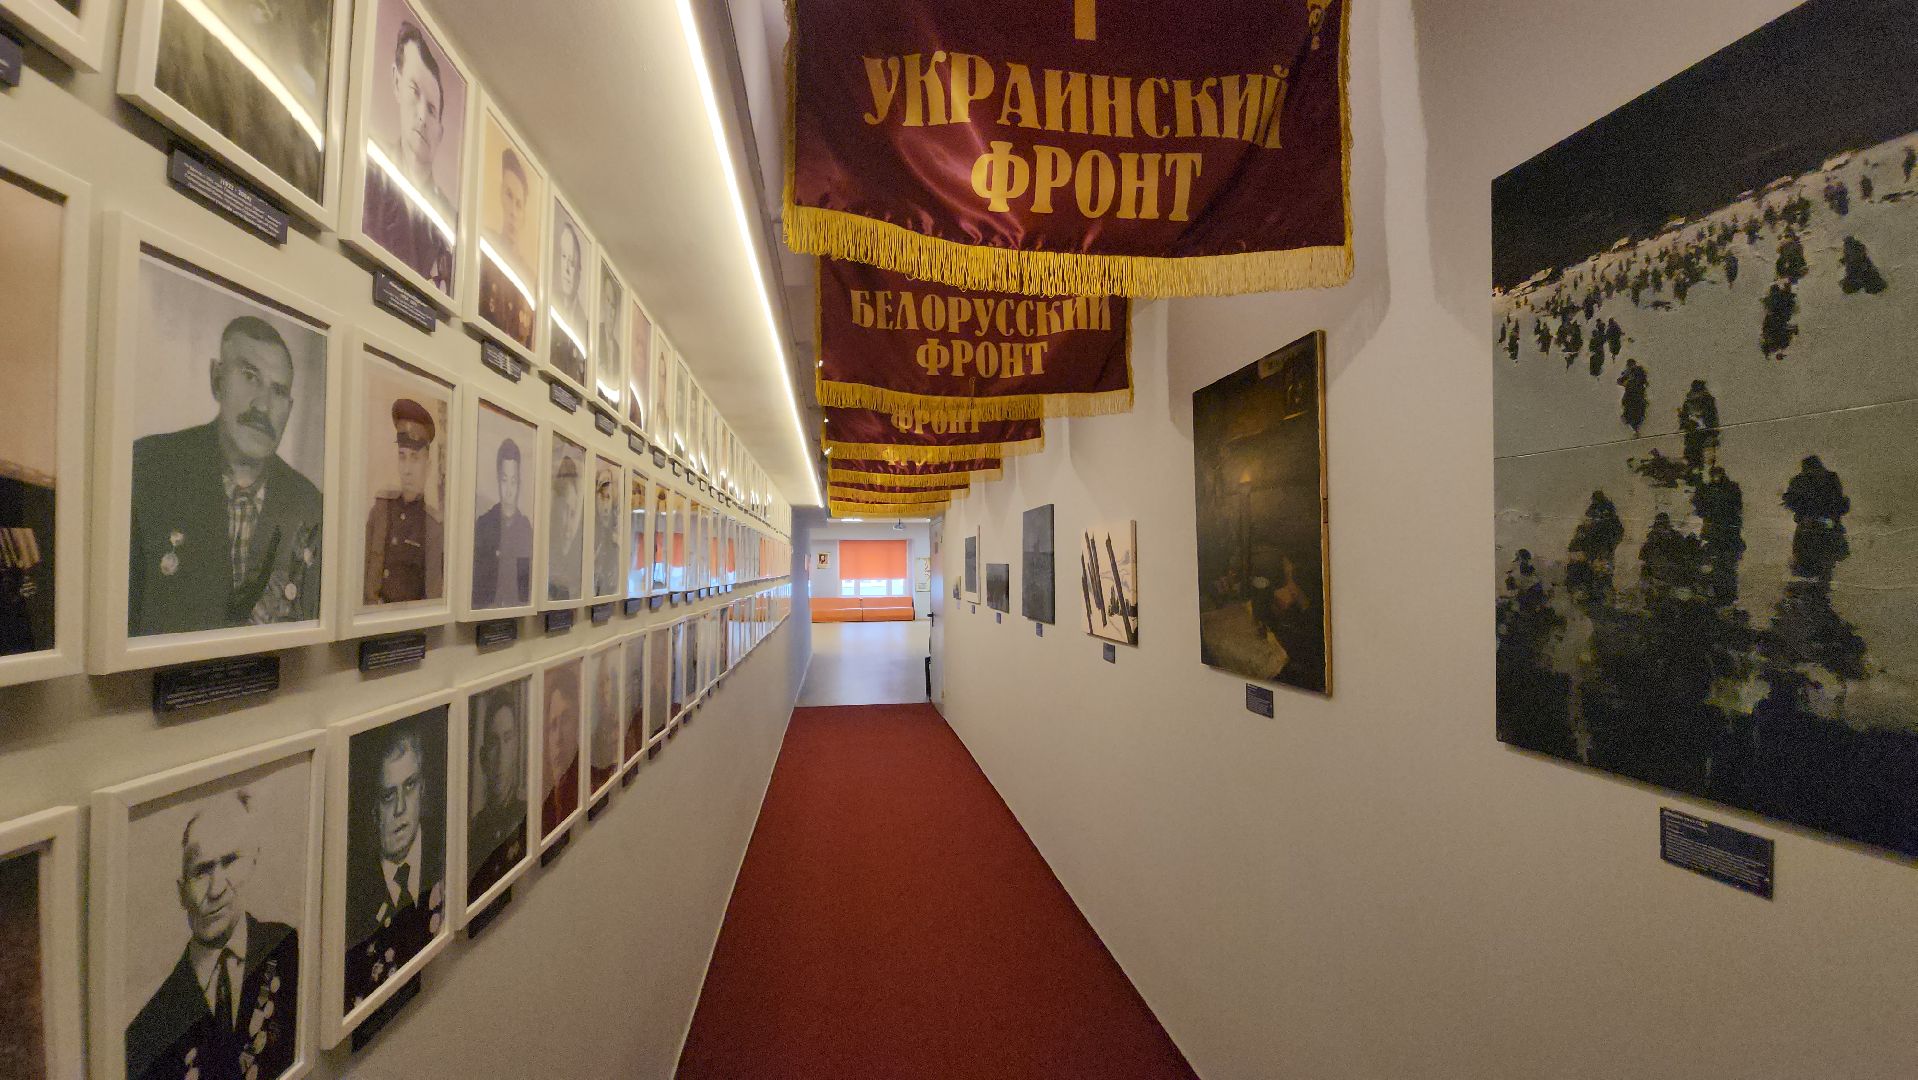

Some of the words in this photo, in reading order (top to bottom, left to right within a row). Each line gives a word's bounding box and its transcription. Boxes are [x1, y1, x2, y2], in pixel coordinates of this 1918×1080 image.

[862, 50, 1287, 149] УКРАИНСКИЙ
[970, 140, 1203, 222] ФРОНТ
[916, 338, 1048, 379] ФРОНТ
